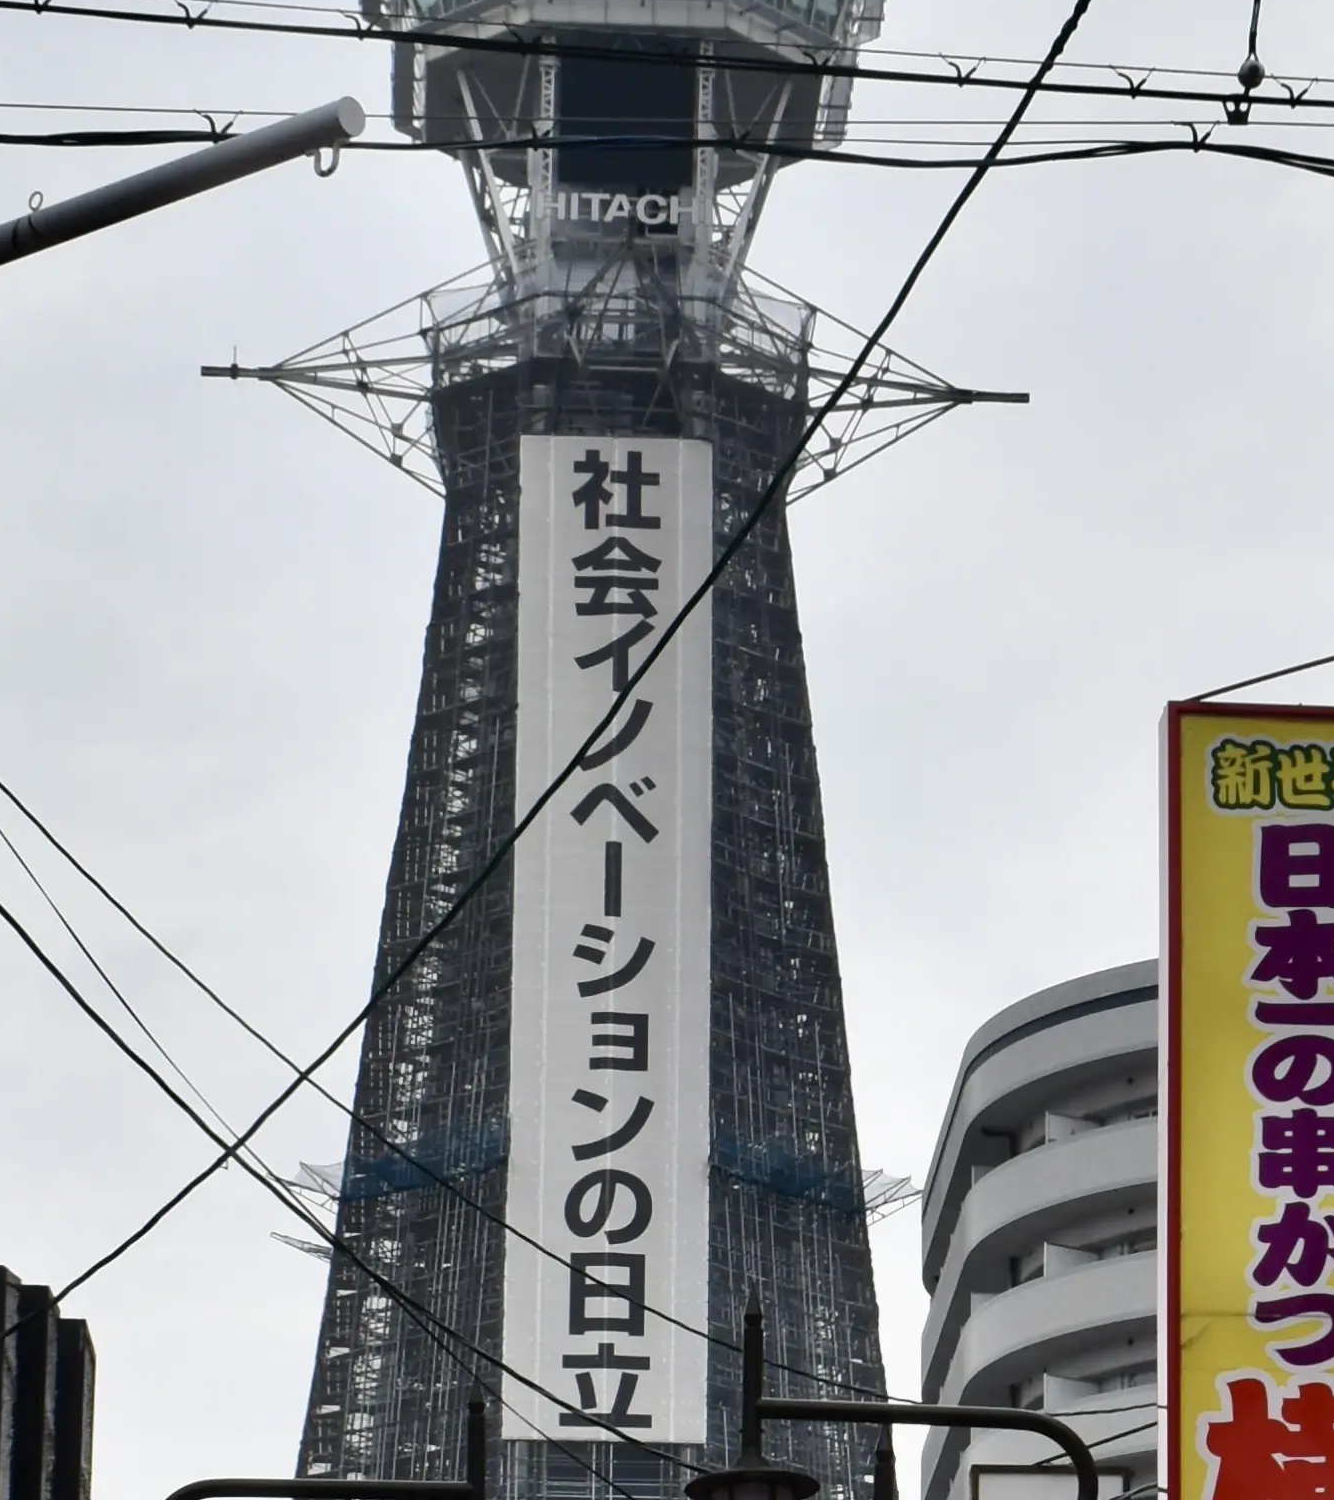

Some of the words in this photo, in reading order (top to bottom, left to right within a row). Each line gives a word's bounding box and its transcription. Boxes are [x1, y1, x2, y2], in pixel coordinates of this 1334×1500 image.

[535, 191, 711, 225] HITACHI
[563, 446, 662, 1434] 社会イノベーションの日立
